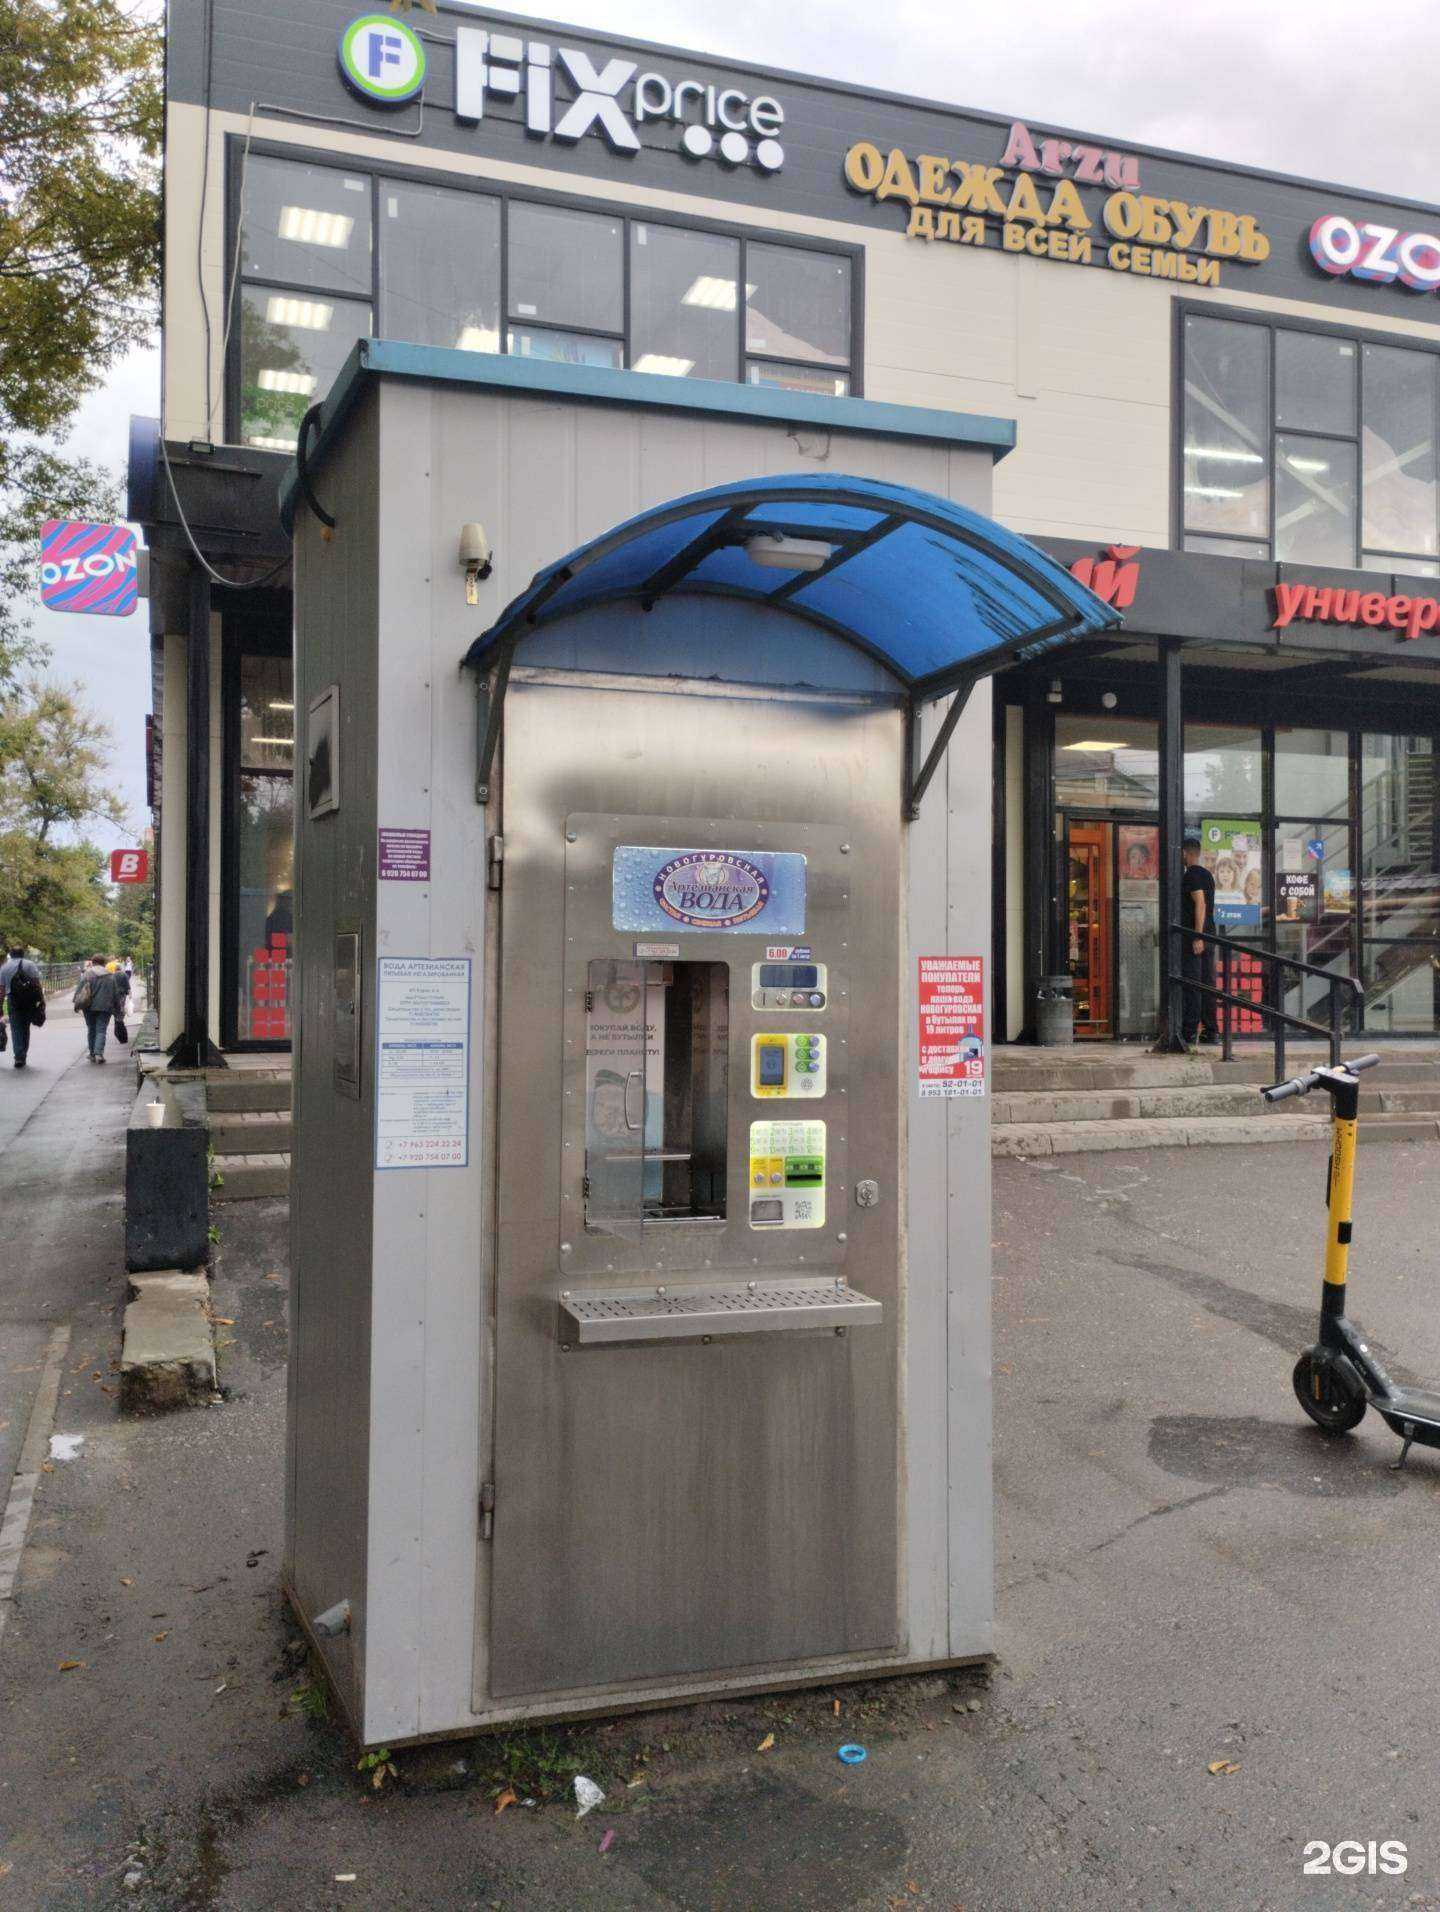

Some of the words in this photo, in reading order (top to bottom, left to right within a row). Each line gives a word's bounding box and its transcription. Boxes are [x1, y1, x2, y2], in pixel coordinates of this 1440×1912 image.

[635, 71, 786, 138] price
[1000, 121, 1140, 190] Arzu
[844, 142, 1092, 230] ОДЕЖДА
[1103, 191, 1270, 263] ОБУВЬ
[908, 216, 986, 246] ДЛЯ
[1002, 225, 1091, 263] ВСЕЙ
[1108, 244, 1220, 286] СЕМЬИ
[41, 550, 137, 585] OZON
[1273, 583, 1440, 640] универ
[658, 853, 765, 884] НОВОГУРОВСКАЯ
[1285, 875, 1309, 885] КОФЕ
[680, 892, 743, 910] ВОДА
[1280, 887, 1286, 896] С
[1288, 884, 1315, 897] СОБОЙ
[408, 963, 464, 971] АРТЕЗИАНСКАЯ
[921, 960, 980, 971] УВАЖАЕМЫЕ
